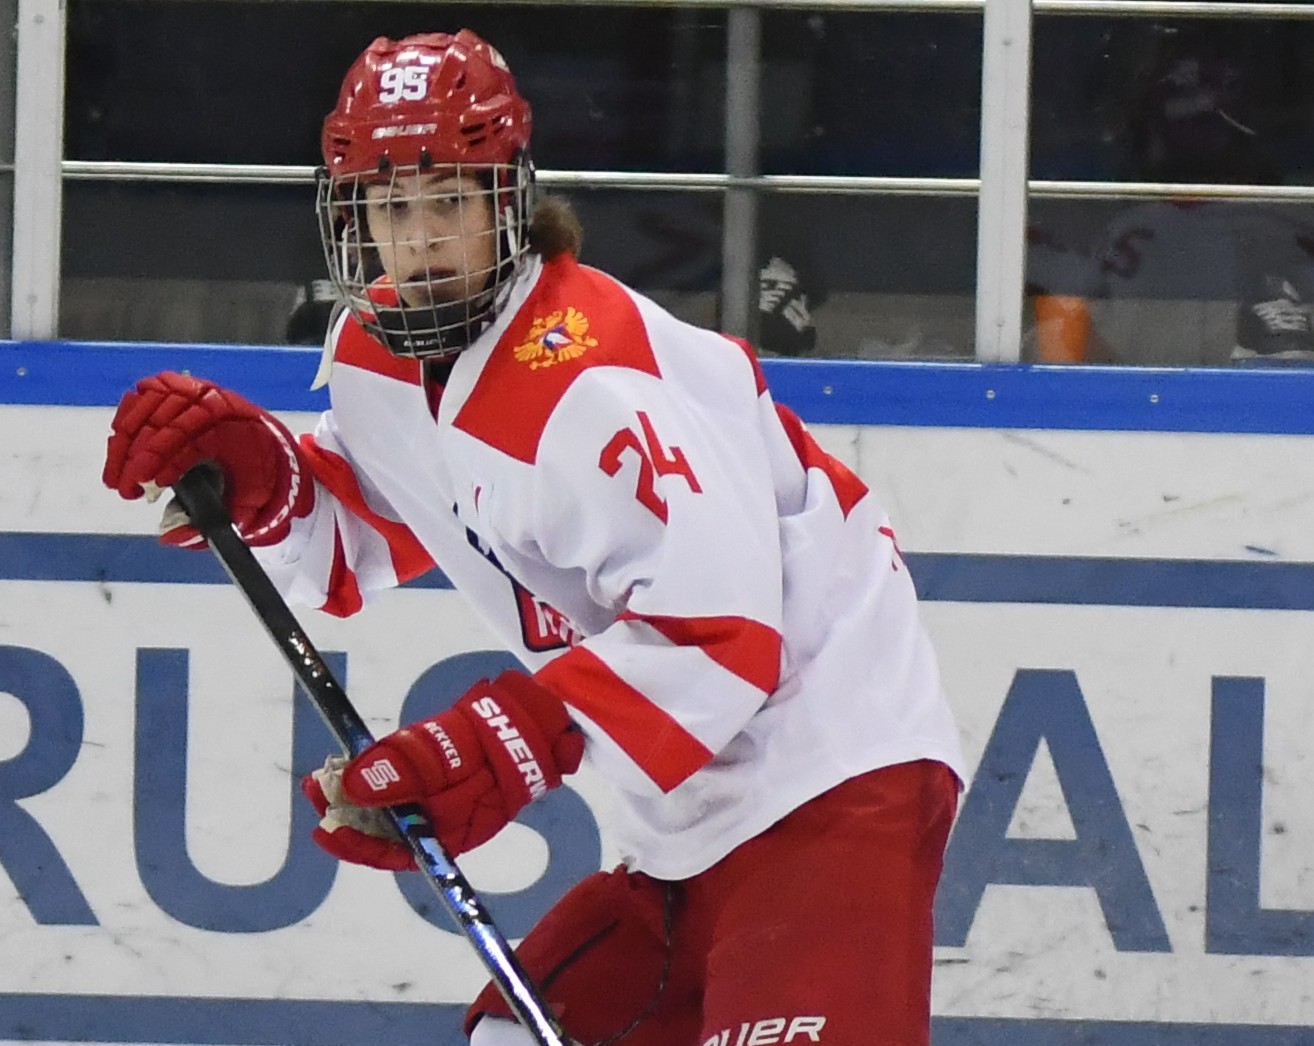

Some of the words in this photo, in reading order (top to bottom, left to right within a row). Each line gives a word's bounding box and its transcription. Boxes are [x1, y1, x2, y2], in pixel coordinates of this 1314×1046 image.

[379, 66, 430, 104] 95
[598, 410, 703, 527] 24
[470, 697, 548, 801] SHERW
